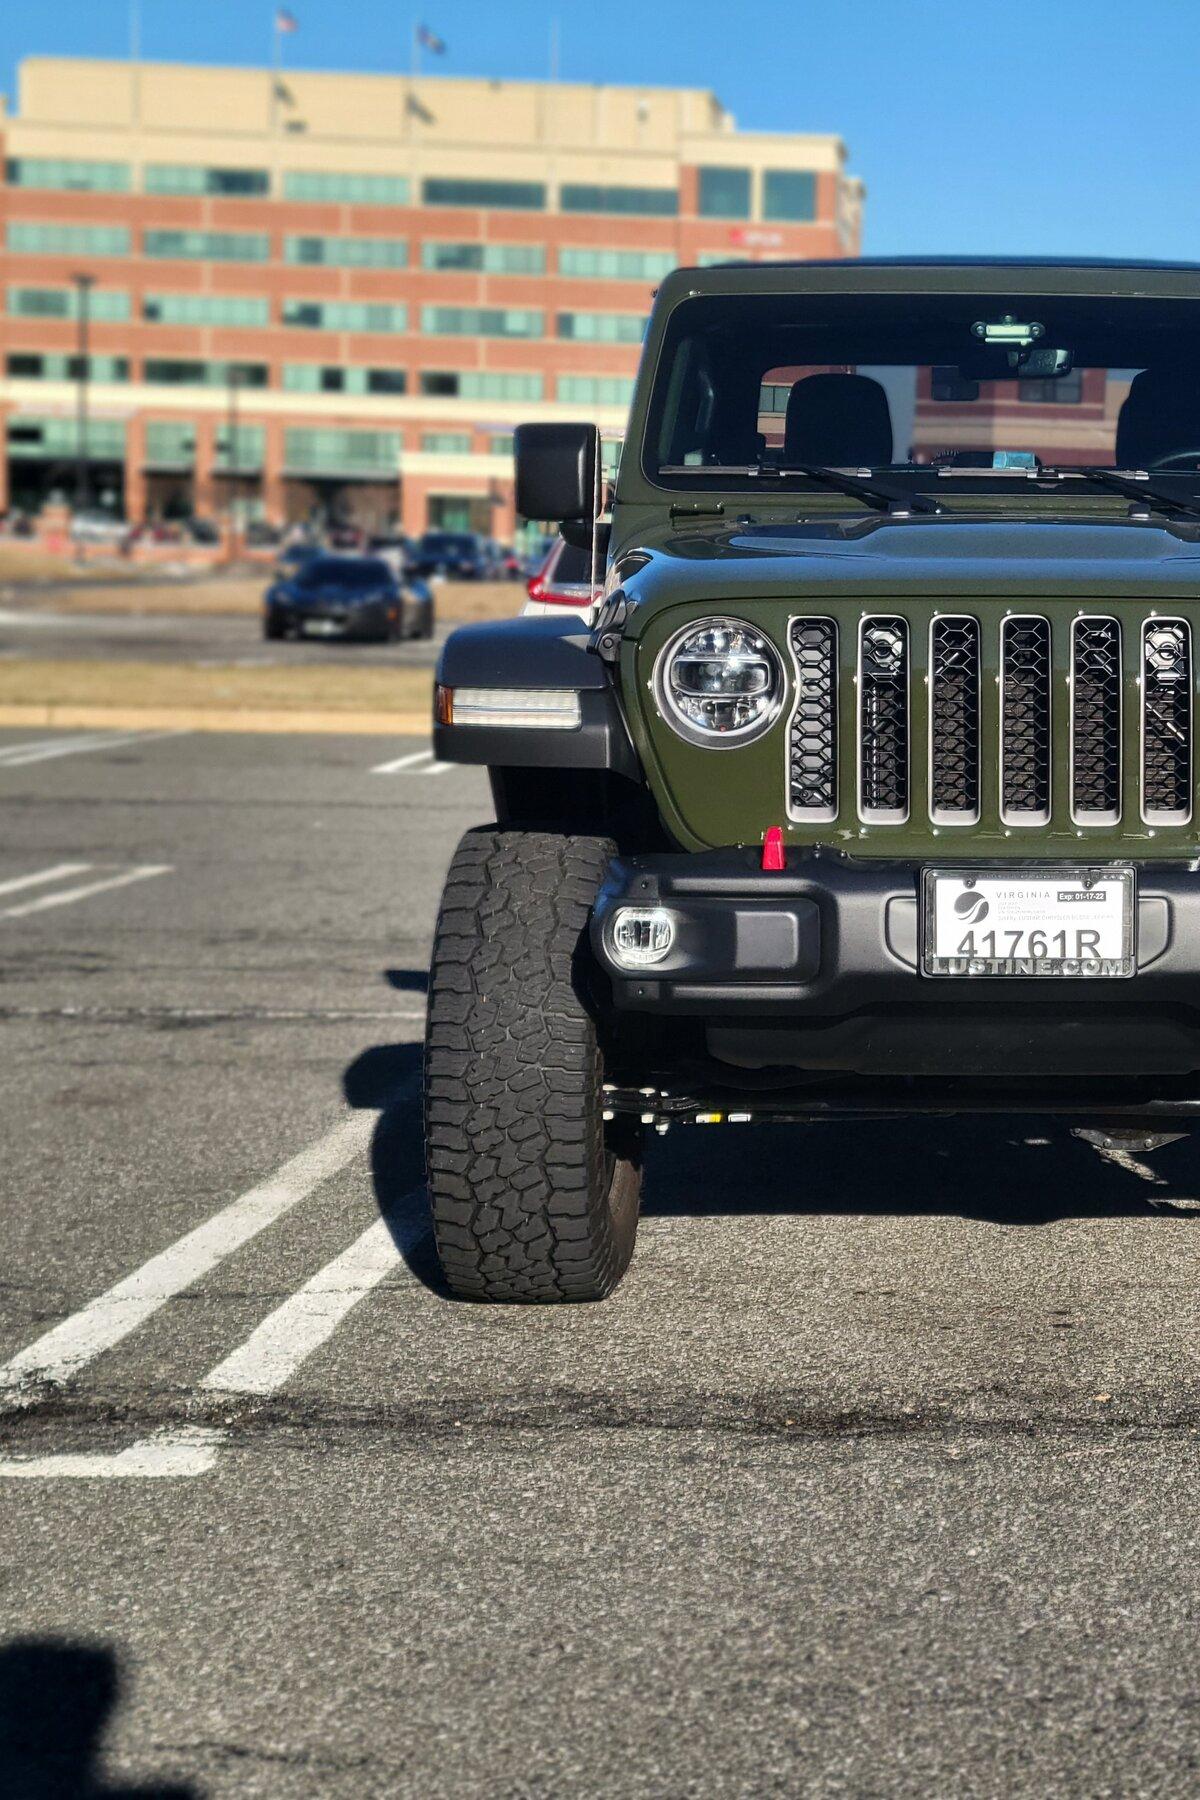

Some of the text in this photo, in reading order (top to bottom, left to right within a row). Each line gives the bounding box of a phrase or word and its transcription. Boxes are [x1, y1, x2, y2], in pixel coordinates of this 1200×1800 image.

[996, 891, 1051, 899] VIRGINIA
[1059, 892, 1105, 901] Exp: 01-17-22
[956, 929, 1101, 958] 41761R
[933, 957, 1123, 976] LUSTINE.COM
